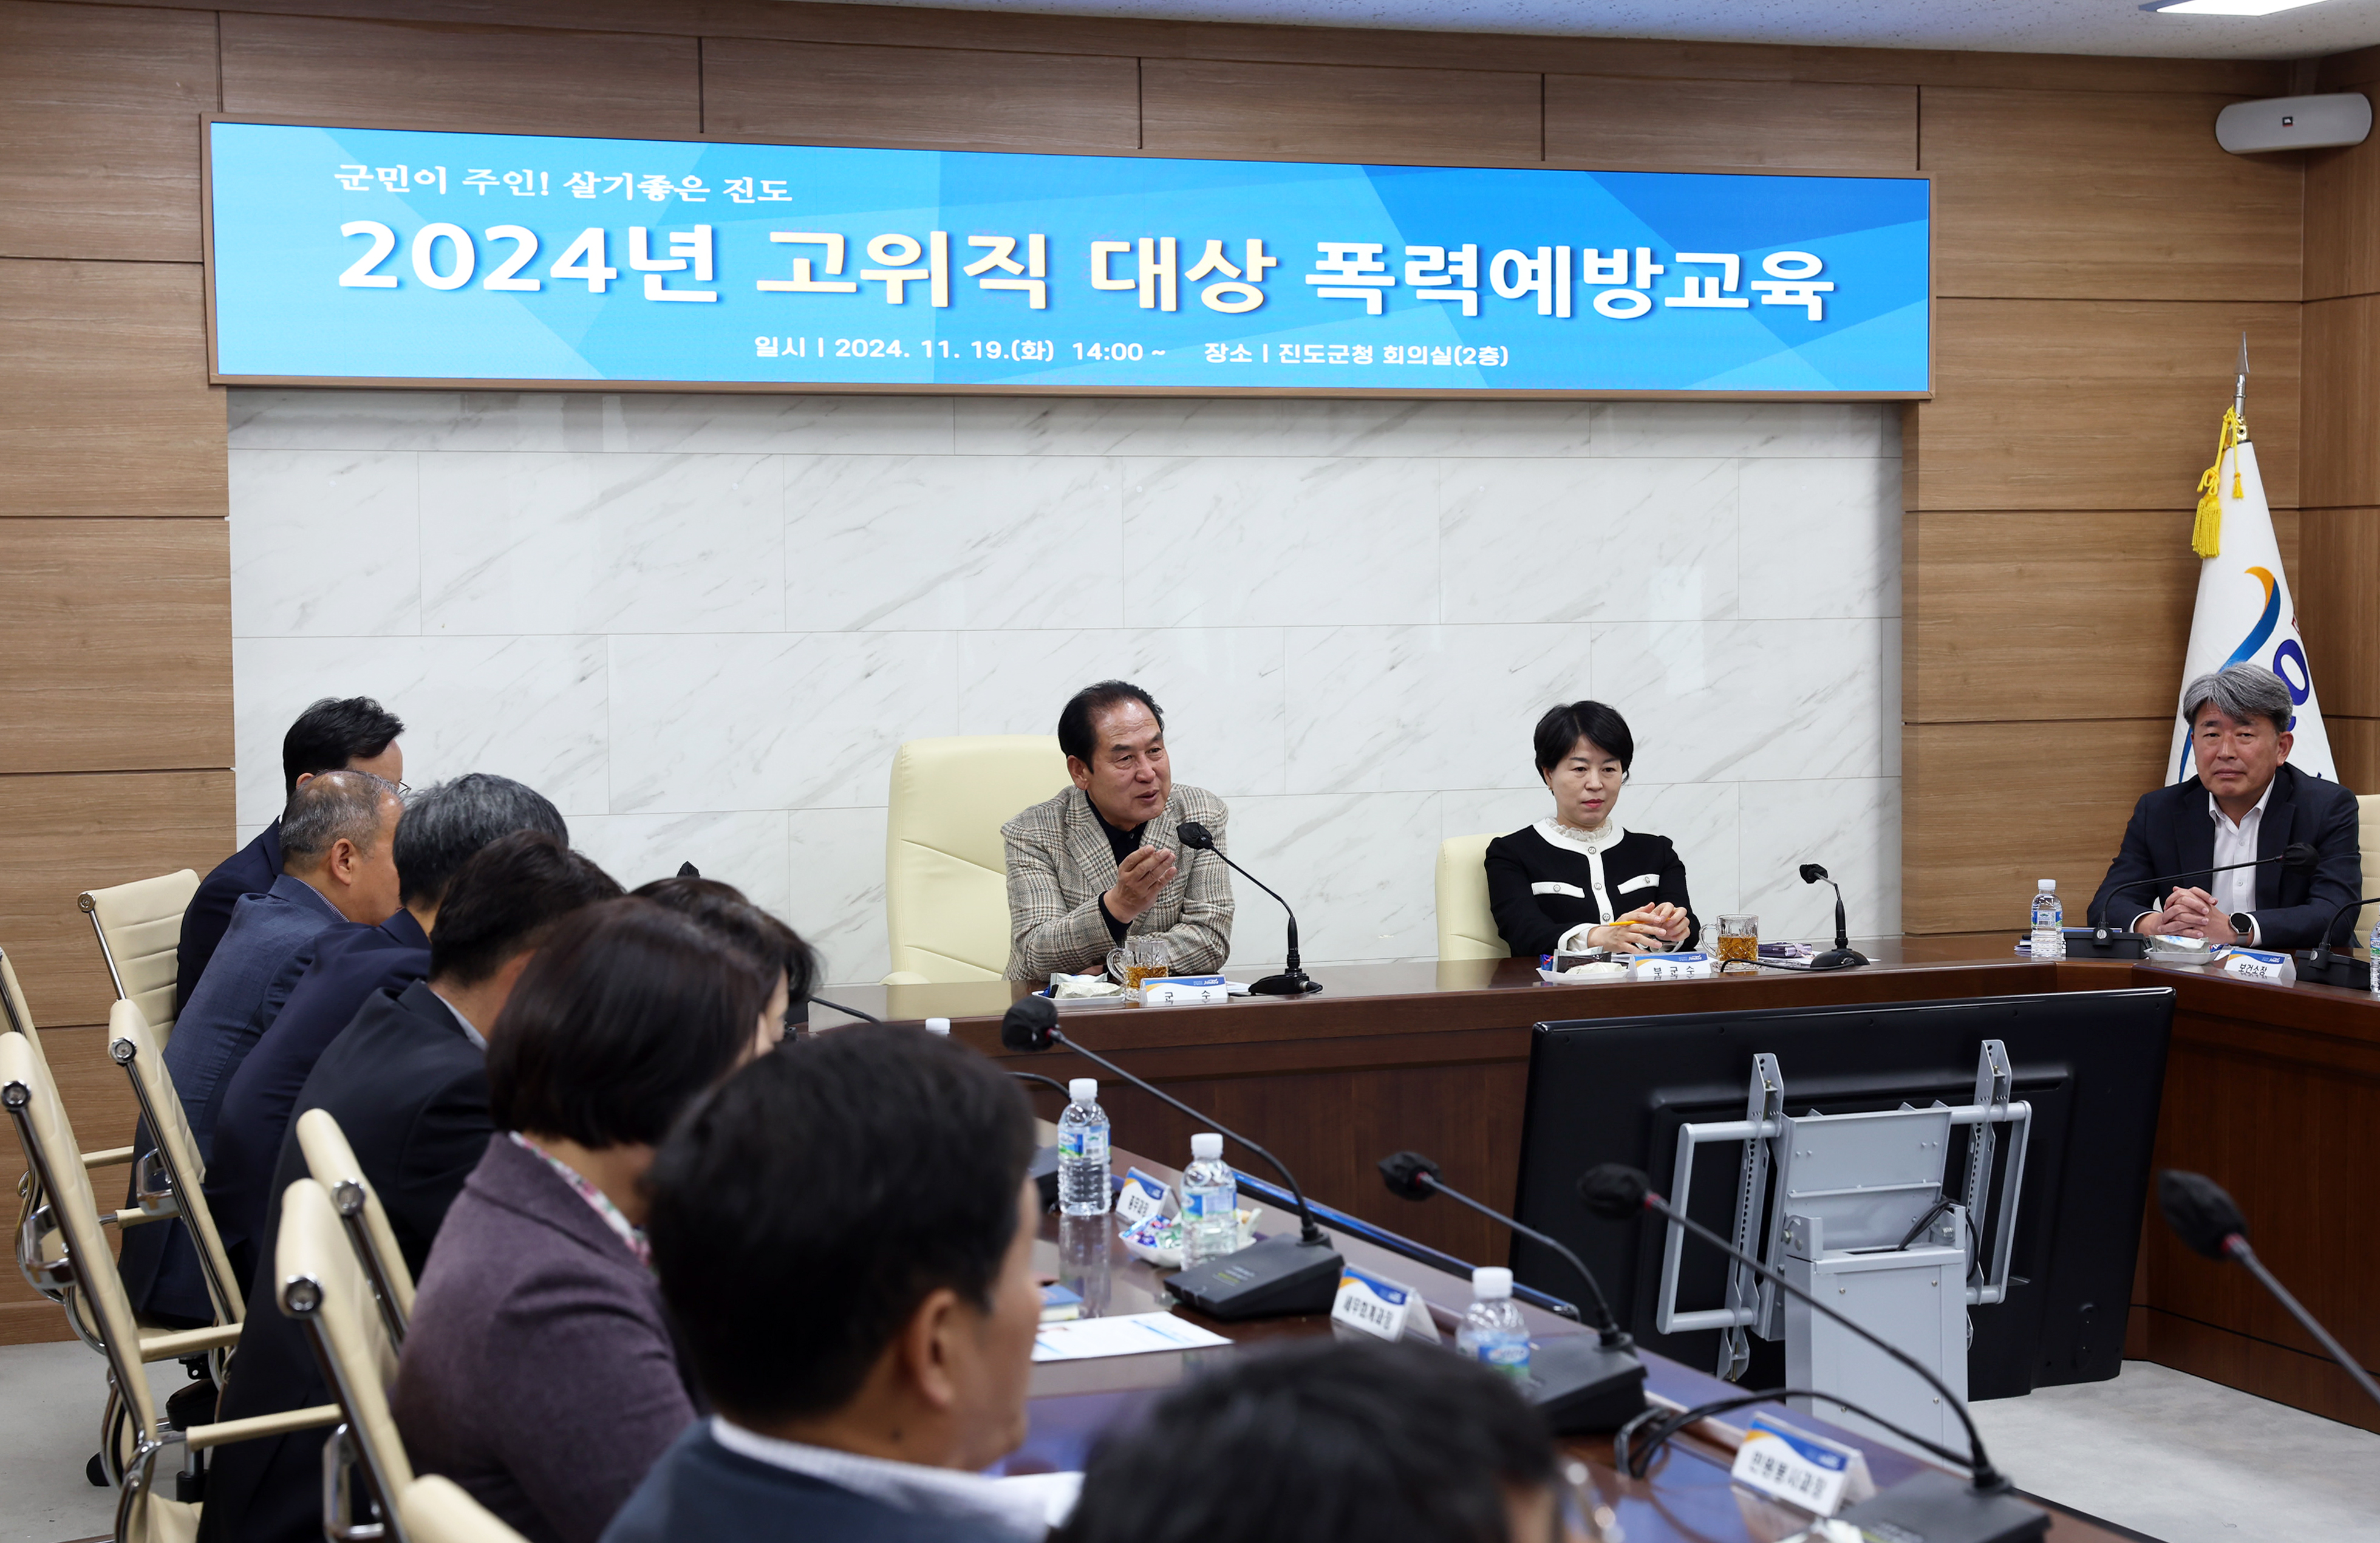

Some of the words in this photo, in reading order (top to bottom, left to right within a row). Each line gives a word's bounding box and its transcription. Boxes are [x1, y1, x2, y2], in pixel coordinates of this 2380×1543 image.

[334, 164, 447, 195] 군민이
[462, 169, 550, 196] 주인!
[562, 171, 711, 202] 살기좋은
[723, 177, 793, 203] 진도
[338, 220, 718, 304] 2024년
[756, 231, 1047, 310] 고위직
[1091, 237, 1278, 314] 대상
[1304, 242, 1835, 321] 폭력예방교육
[754, 336, 806, 358] 일시
[834, 338, 910, 358] 2024.
[921, 340, 960, 358] 11.
[970, 339, 1054, 362] 19.(화)
[1072, 342, 1144, 361] 14:00
[1204, 343, 1252, 363] 장소
[1279, 344, 1374, 364] 진도군청
[1383, 344, 1509, 367] 회의실(2층)
[2238, 964, 2268, 976] 보건소장
